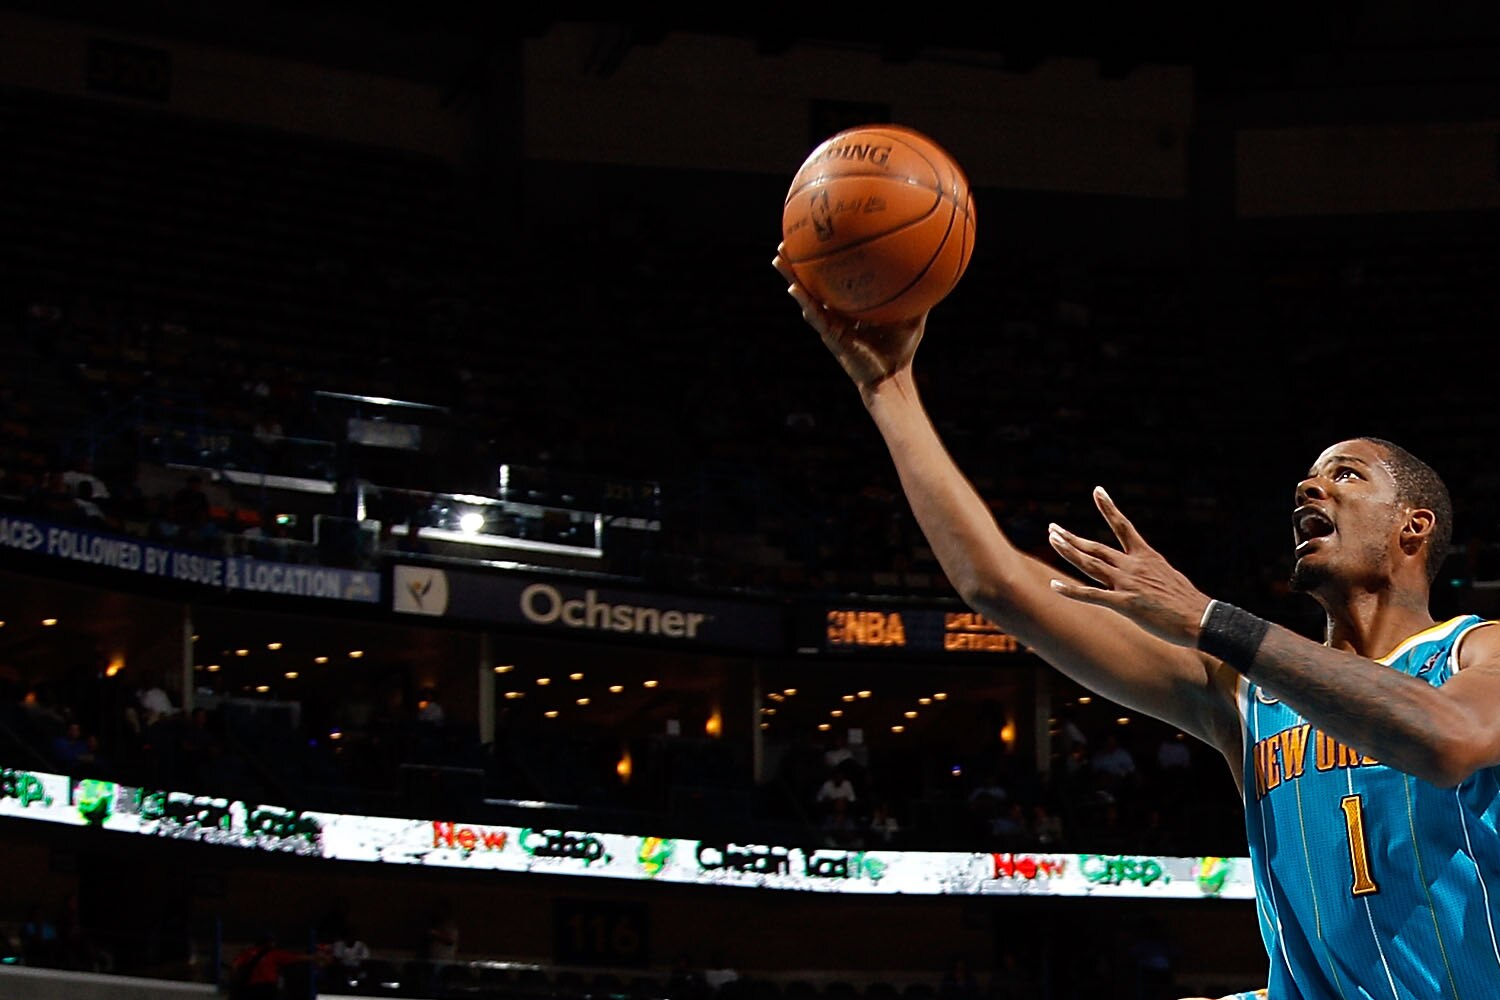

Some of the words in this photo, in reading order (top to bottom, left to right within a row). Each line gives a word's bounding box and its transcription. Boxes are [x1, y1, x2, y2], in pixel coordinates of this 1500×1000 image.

[48, 530, 141, 571] FOLLOWED
[145, 546, 169, 577] BY
[172, 552, 223, 586] ISSUE
[245, 558, 341, 599] LOCATION
[519, 583, 706, 639] Ochsner
[1253, 722, 1312, 801] NEW
[433, 820, 508, 850] New
[992, 852, 1066, 879] New
[1340, 794, 1380, 898] 1
